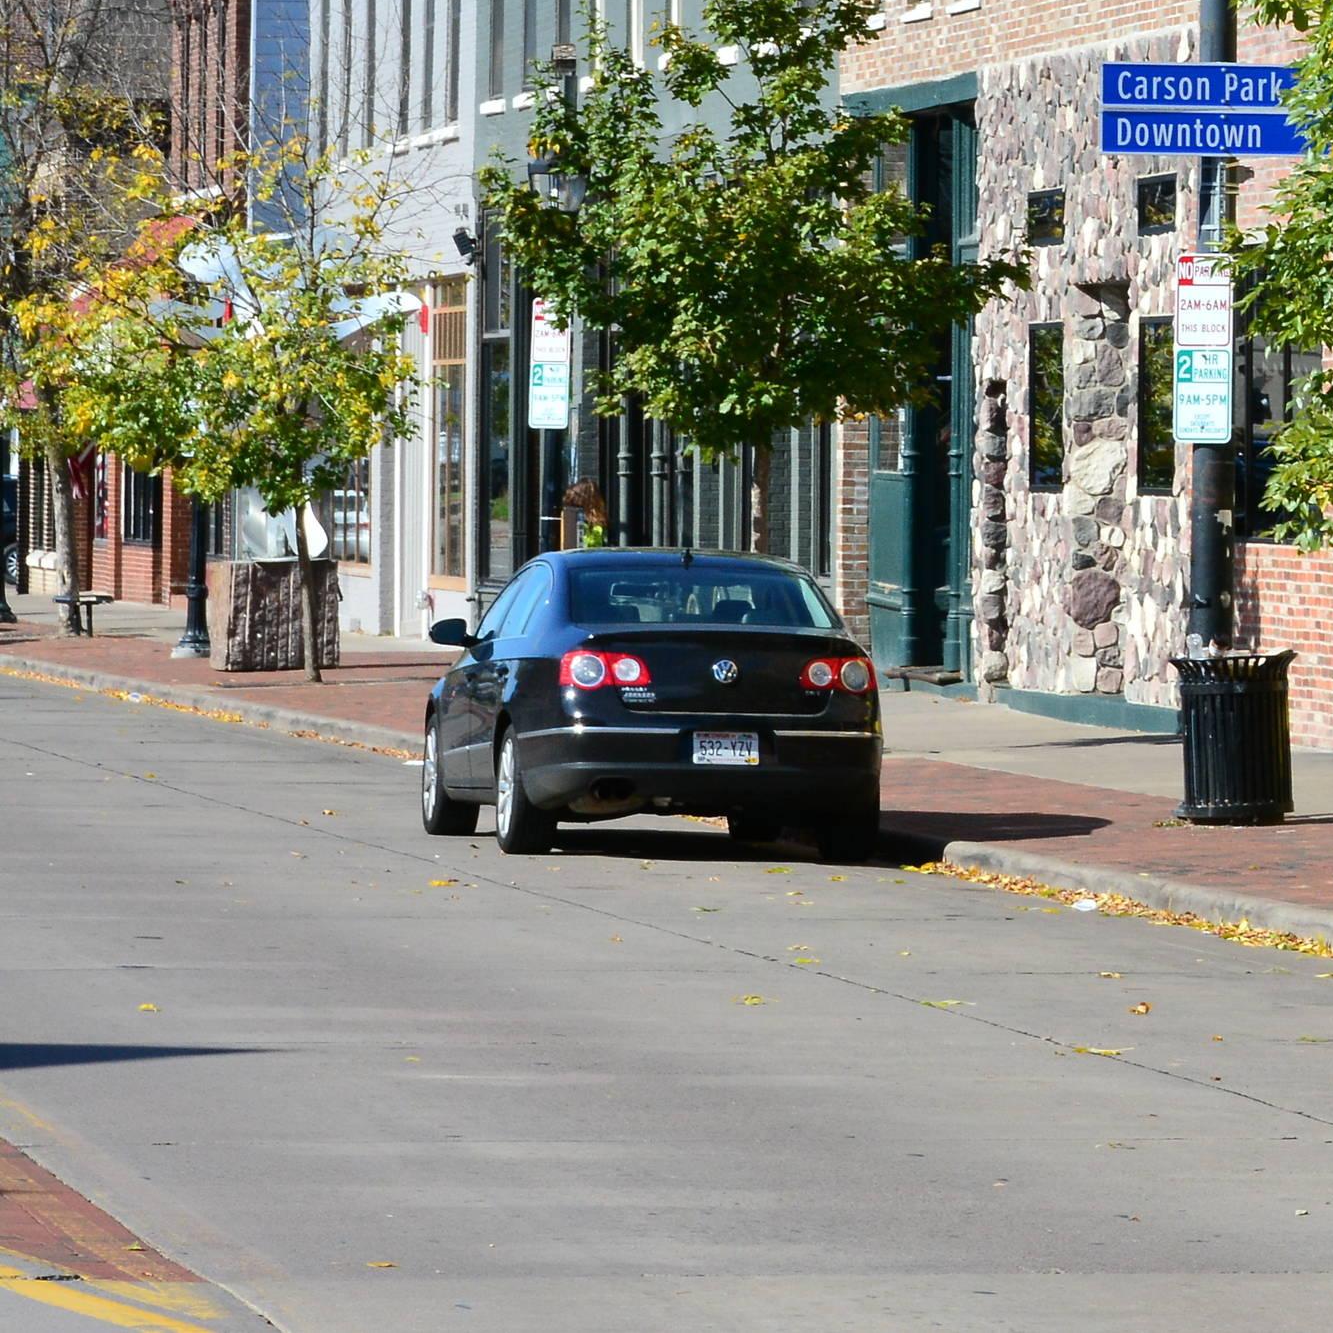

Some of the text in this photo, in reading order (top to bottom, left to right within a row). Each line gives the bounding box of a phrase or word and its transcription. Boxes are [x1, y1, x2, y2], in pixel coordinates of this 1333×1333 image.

[1117, 71, 1211, 101] Carson
[1117, 117, 1262, 148] Downtown
[1179, 262, 1193, 279] NO
[1180, 298, 1228, 311] 2AM-6AM
[1181, 323, 1227, 333] THIS BLOCK
[1203, 354, 1219, 365] HR
[533, 366, 542, 381] 2
[1178, 354, 1192, 380] 2
[1193, 368, 1228, 380] PARKING
[1179, 393, 1228, 406] 9AM-5PM
